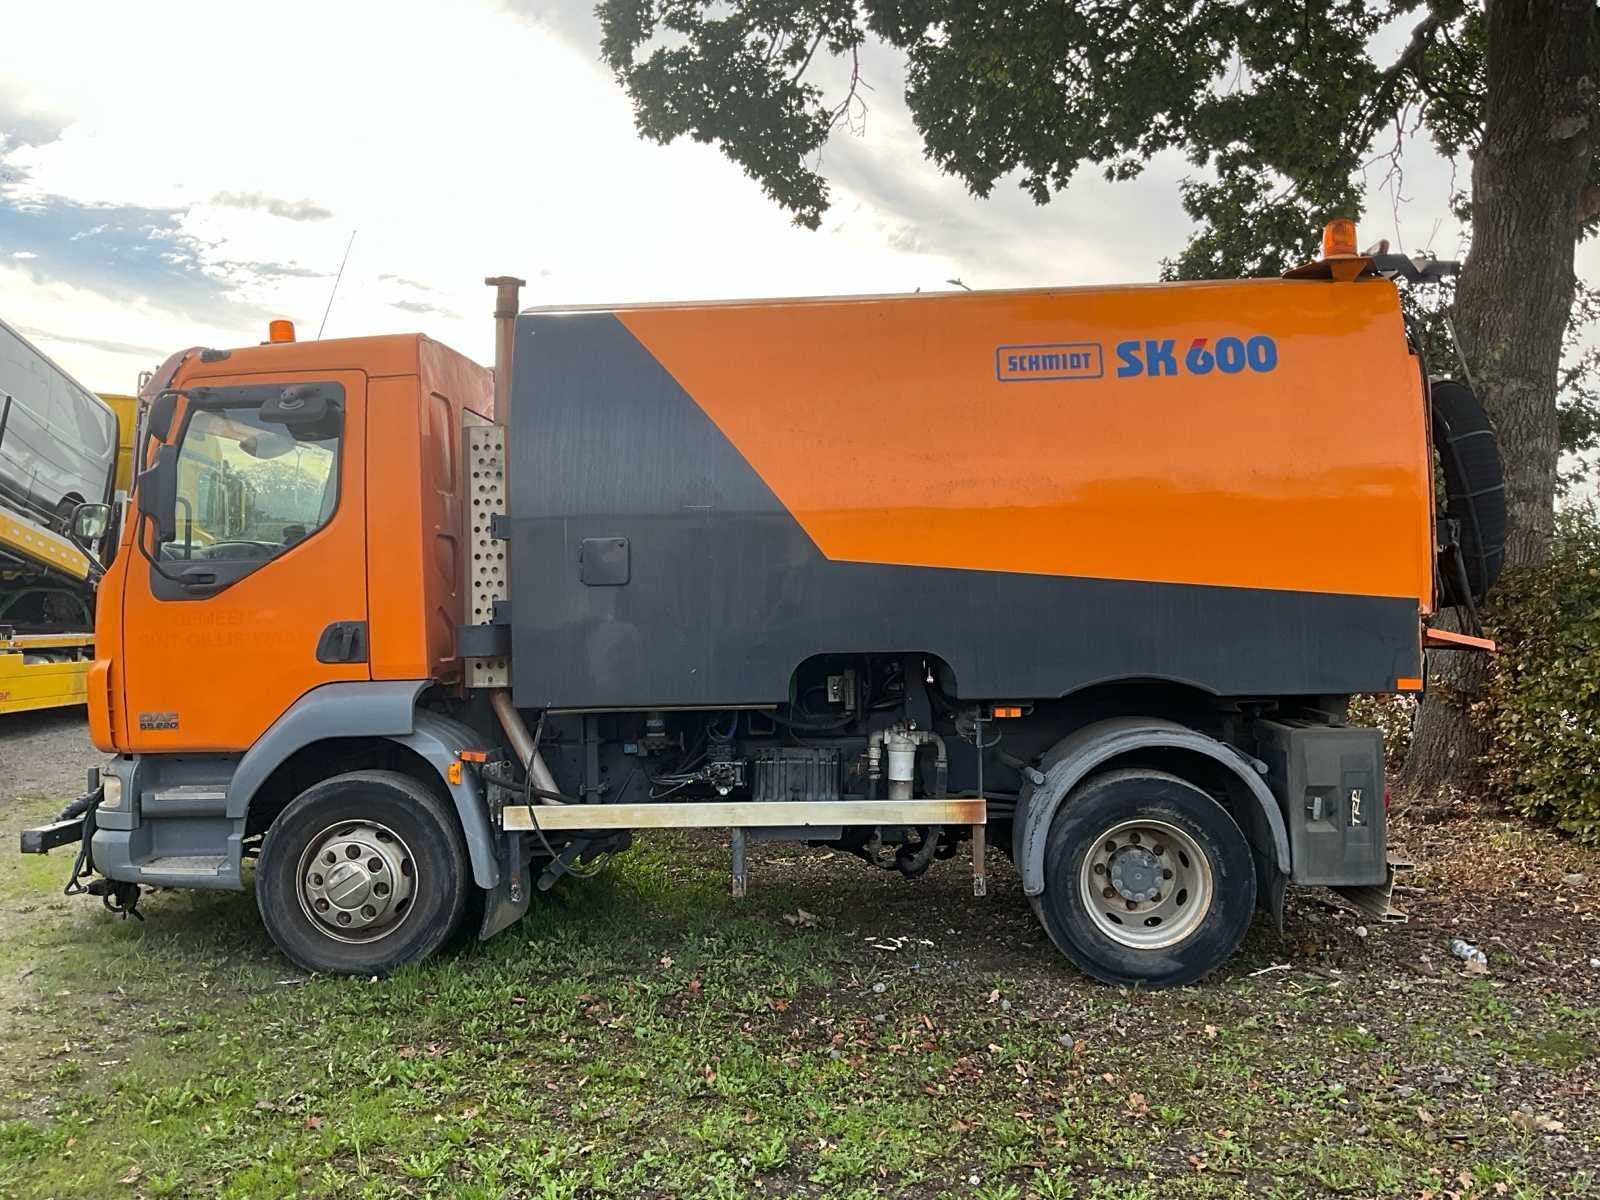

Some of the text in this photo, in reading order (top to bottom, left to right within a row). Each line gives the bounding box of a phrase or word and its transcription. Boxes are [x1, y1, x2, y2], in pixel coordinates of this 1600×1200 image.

[1007, 353, 1091, 372] SCHMIDT
[1116, 335, 1278, 377] SK 600
[139, 712, 177, 721] DAF
